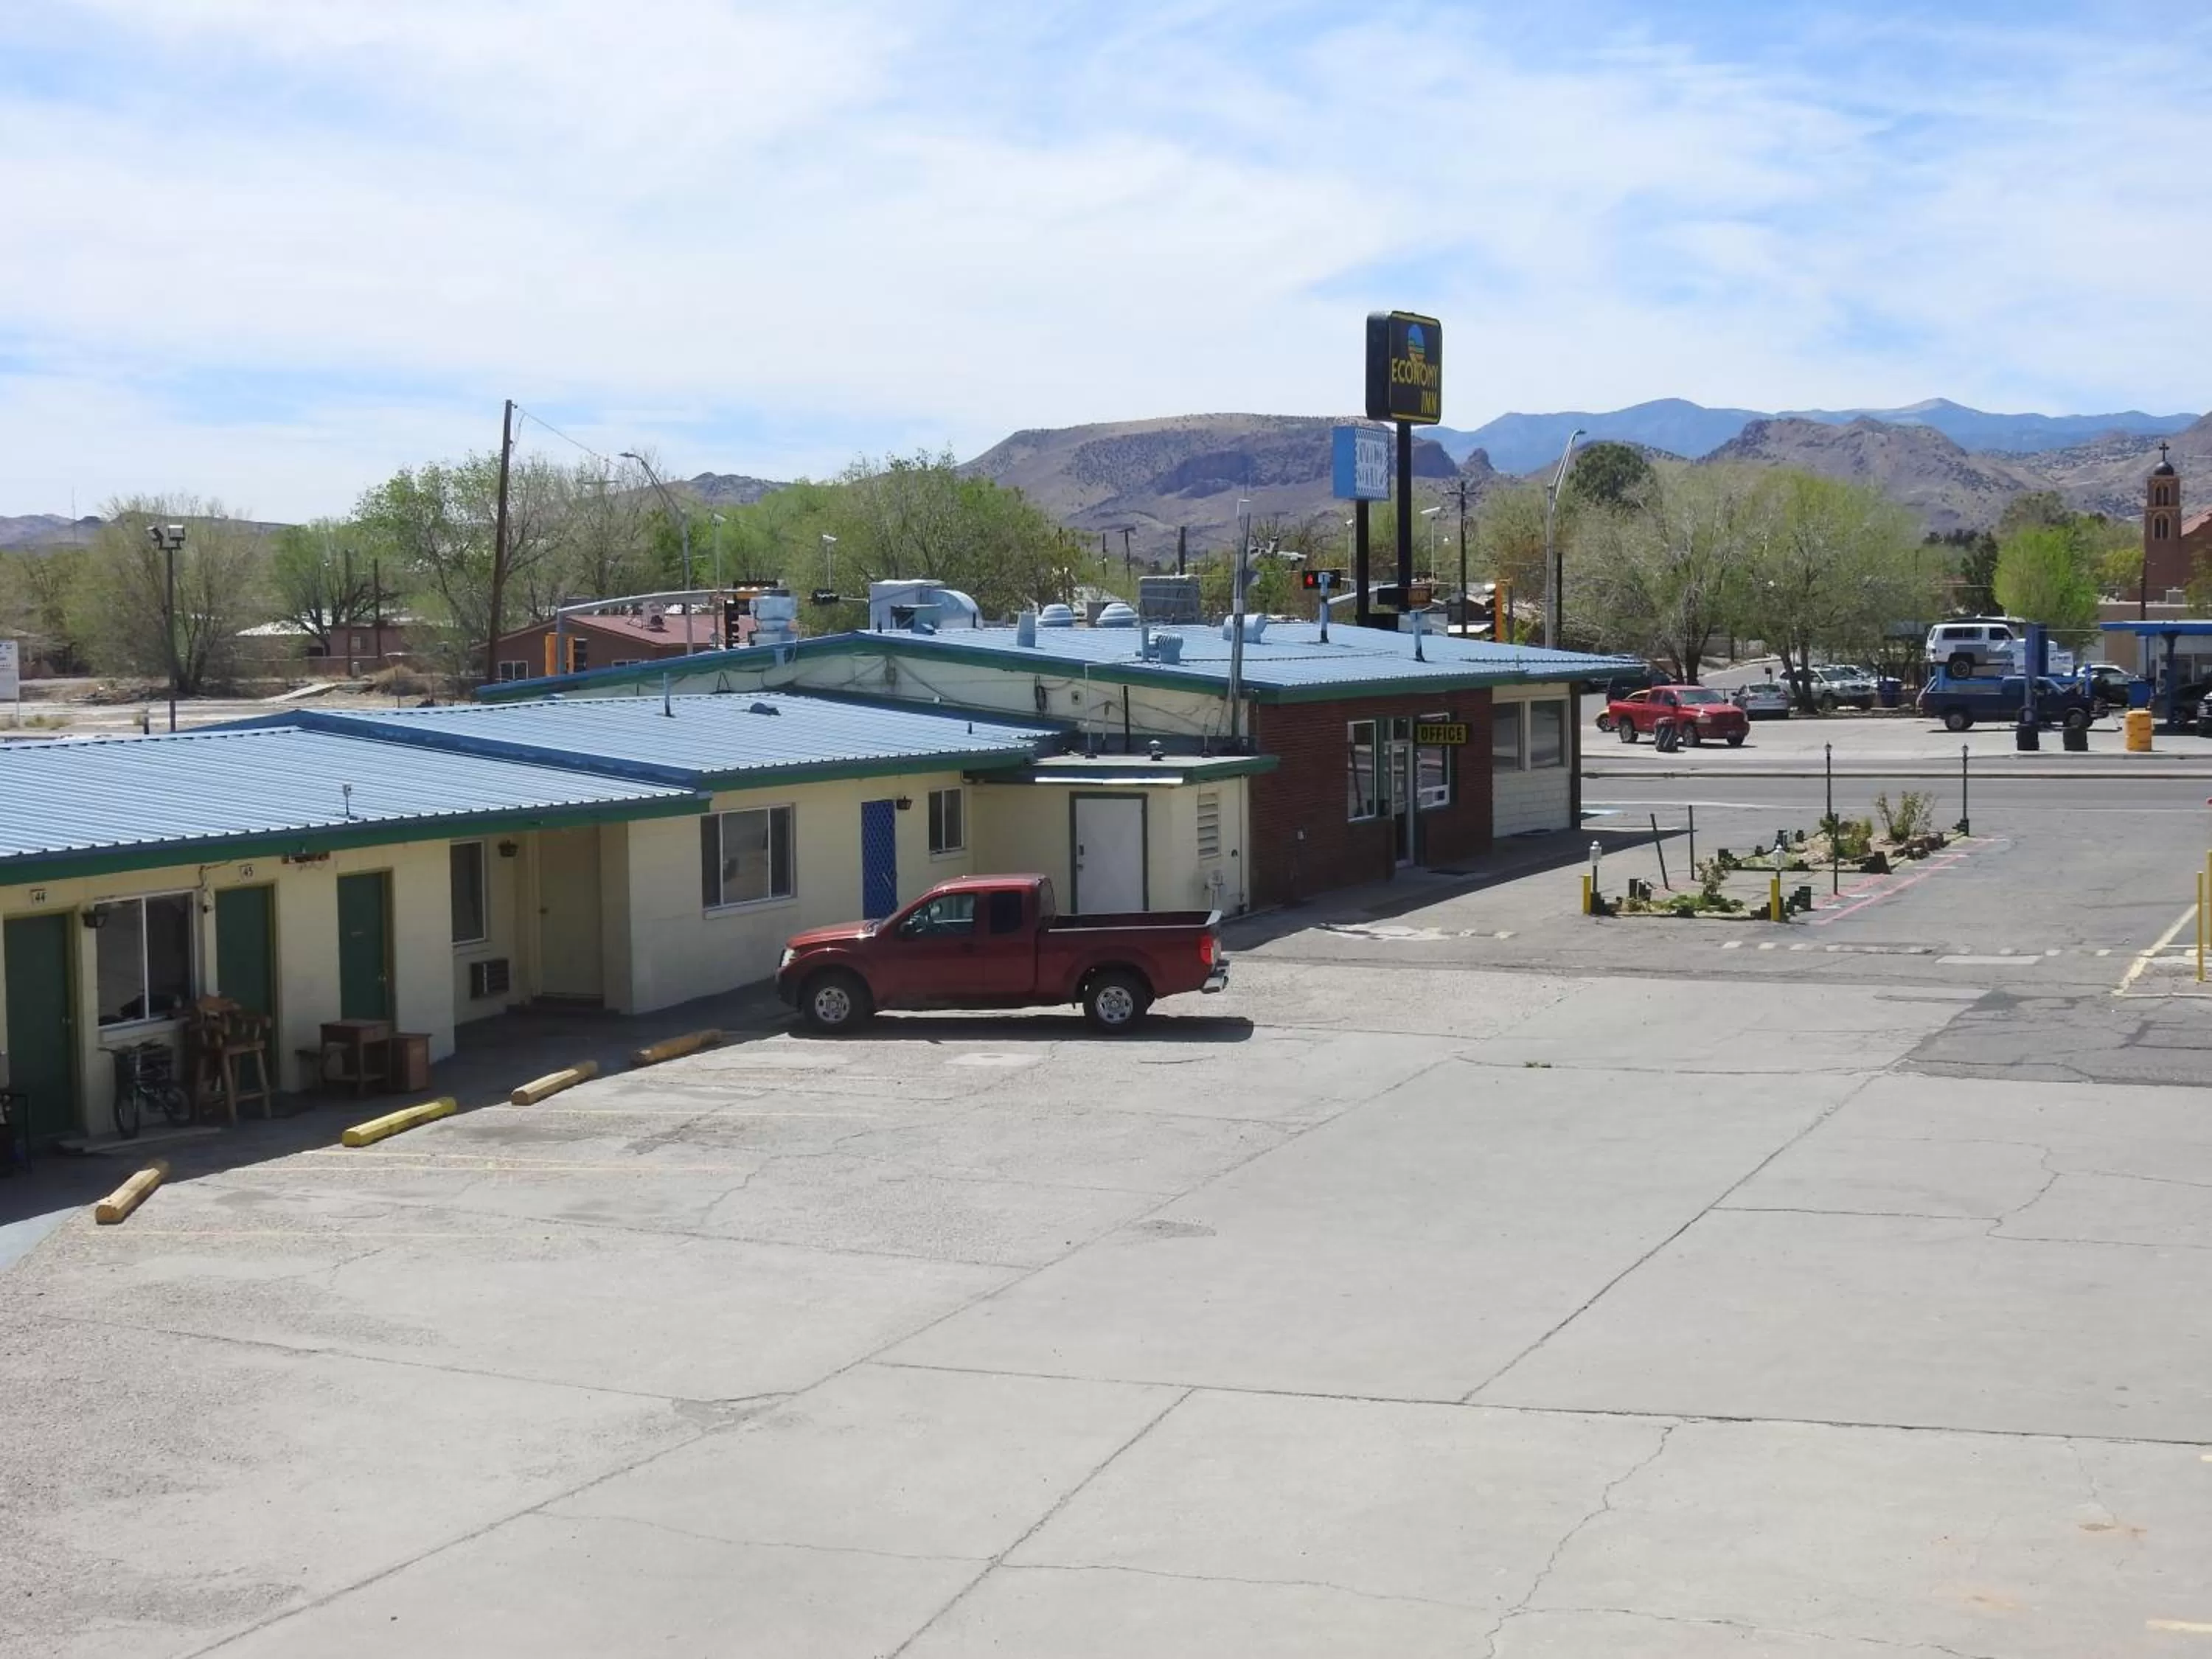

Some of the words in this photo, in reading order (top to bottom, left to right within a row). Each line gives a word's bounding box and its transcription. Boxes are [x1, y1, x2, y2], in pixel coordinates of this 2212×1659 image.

[1391, 358, 1438, 388] ECONOMY
[1421, 389, 1437, 414] INN
[1420, 726, 1463, 741] OFFICE
